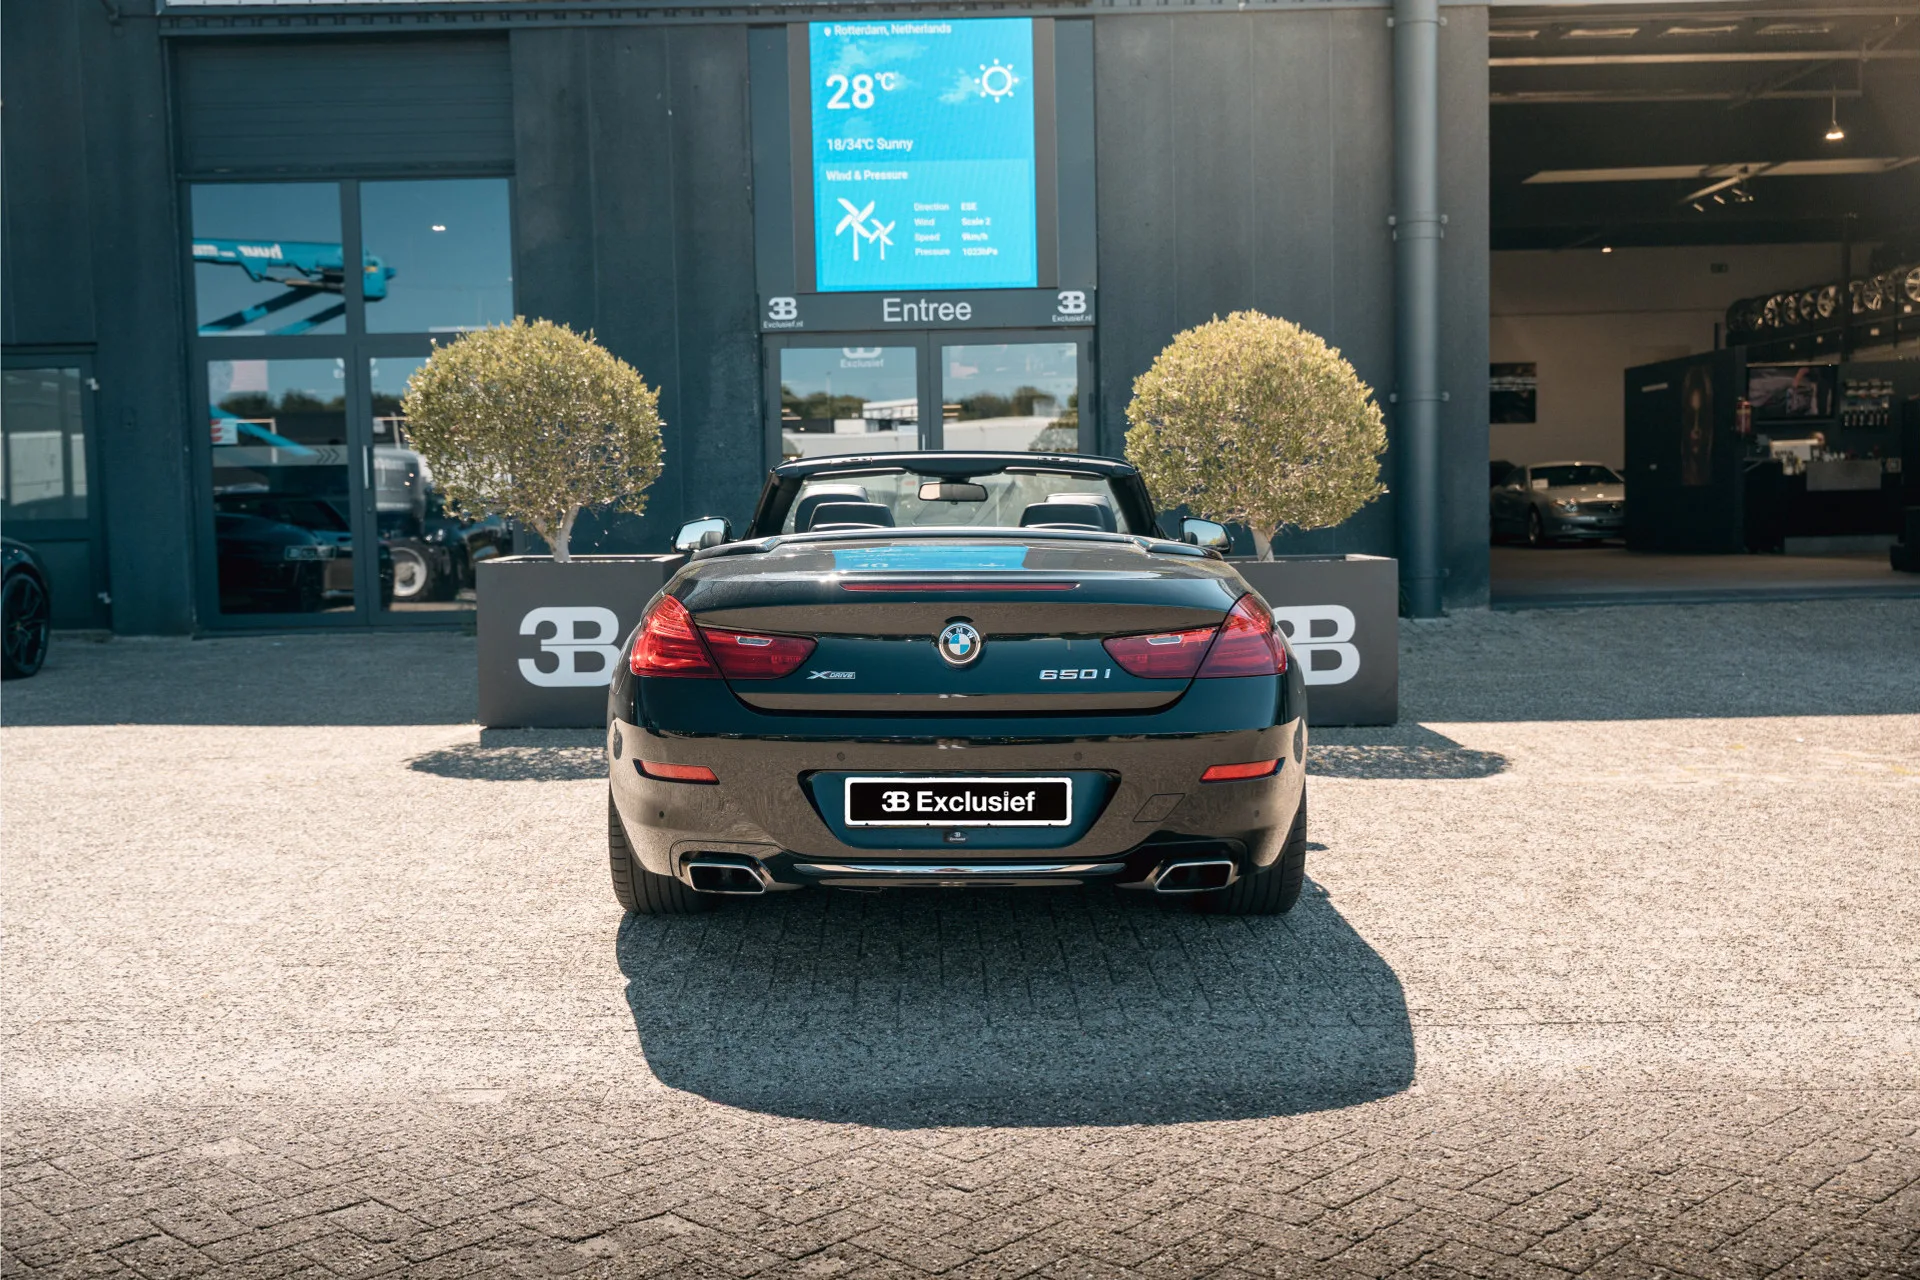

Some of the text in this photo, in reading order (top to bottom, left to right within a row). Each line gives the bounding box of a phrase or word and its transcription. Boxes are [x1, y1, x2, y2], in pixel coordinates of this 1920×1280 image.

[834, 24, 952, 36] Rotterdam, Netherlands
[876, 137, 914, 152] Sunny
[825, 170, 909, 181] Wind & Pressure
[914, 202, 950, 211] Direction
[914, 217, 935, 226] Wind
[915, 232, 941, 242] Speed
[915, 247, 950, 256] Pressure
[882, 298, 972, 322] Entree
[1052, 314, 1092, 323] Exclusief.nl
[763, 320, 804, 329] Exclusief.nl
[840, 358, 884, 368] Exclusief
[916, 790, 1036, 812] Exclusief
